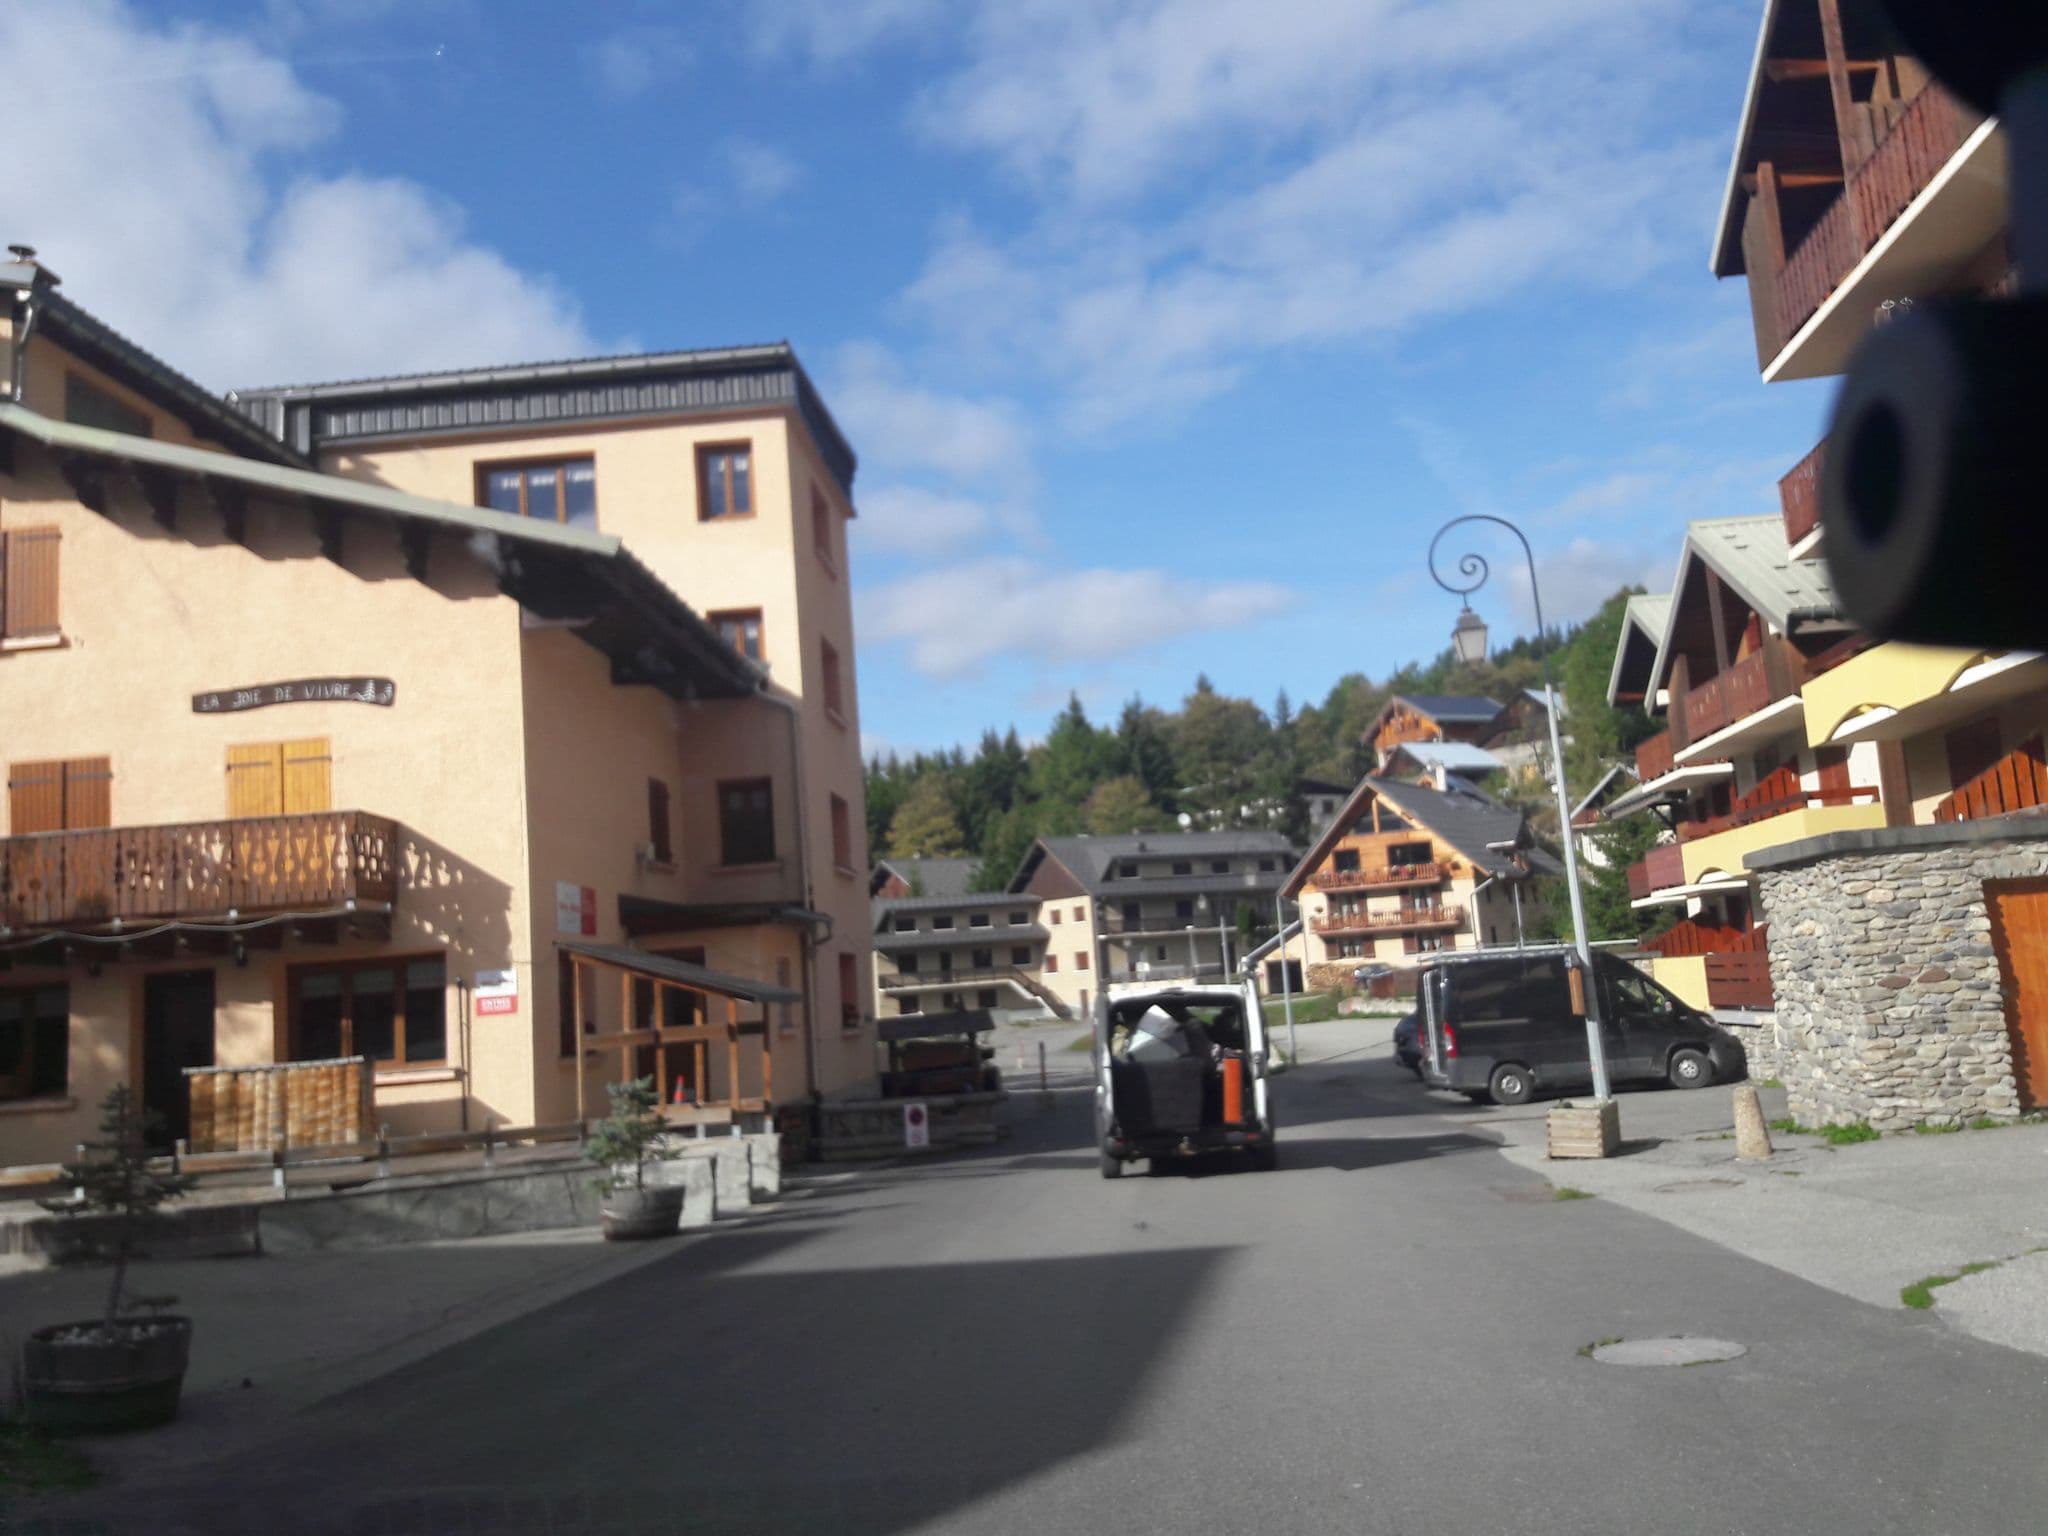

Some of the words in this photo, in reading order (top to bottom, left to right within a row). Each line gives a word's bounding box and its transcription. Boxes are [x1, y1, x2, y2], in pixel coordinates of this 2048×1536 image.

[202, 693, 220, 710] LA
[232, 689, 262, 708] JOIE
[274, 686, 294, 702] DE
[304, 682, 350, 699] VIVRE
